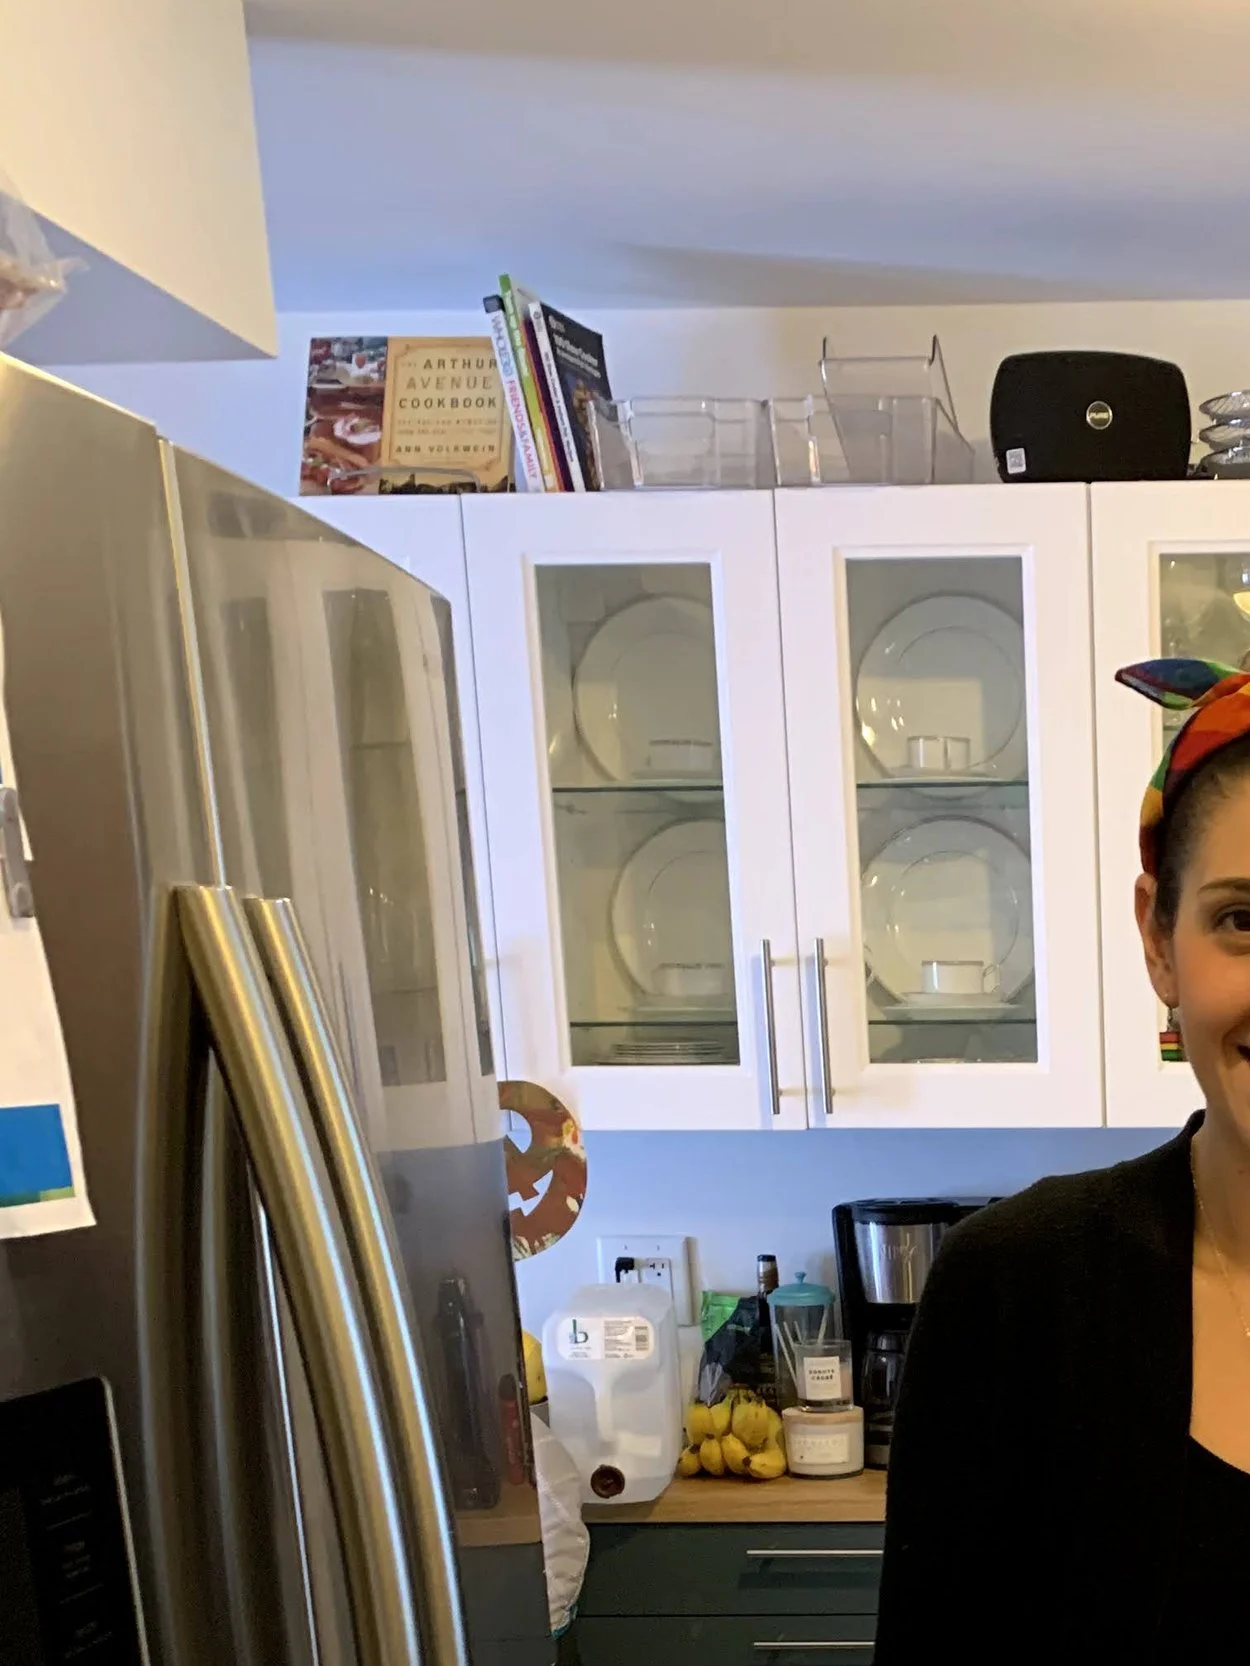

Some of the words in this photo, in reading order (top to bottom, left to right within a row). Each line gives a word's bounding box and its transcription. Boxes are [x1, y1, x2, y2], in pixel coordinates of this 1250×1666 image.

[423, 358, 497, 370] ARTHUR
[406, 376, 493, 390] AVENUE
[398, 397, 497, 409] COOKBOOK
